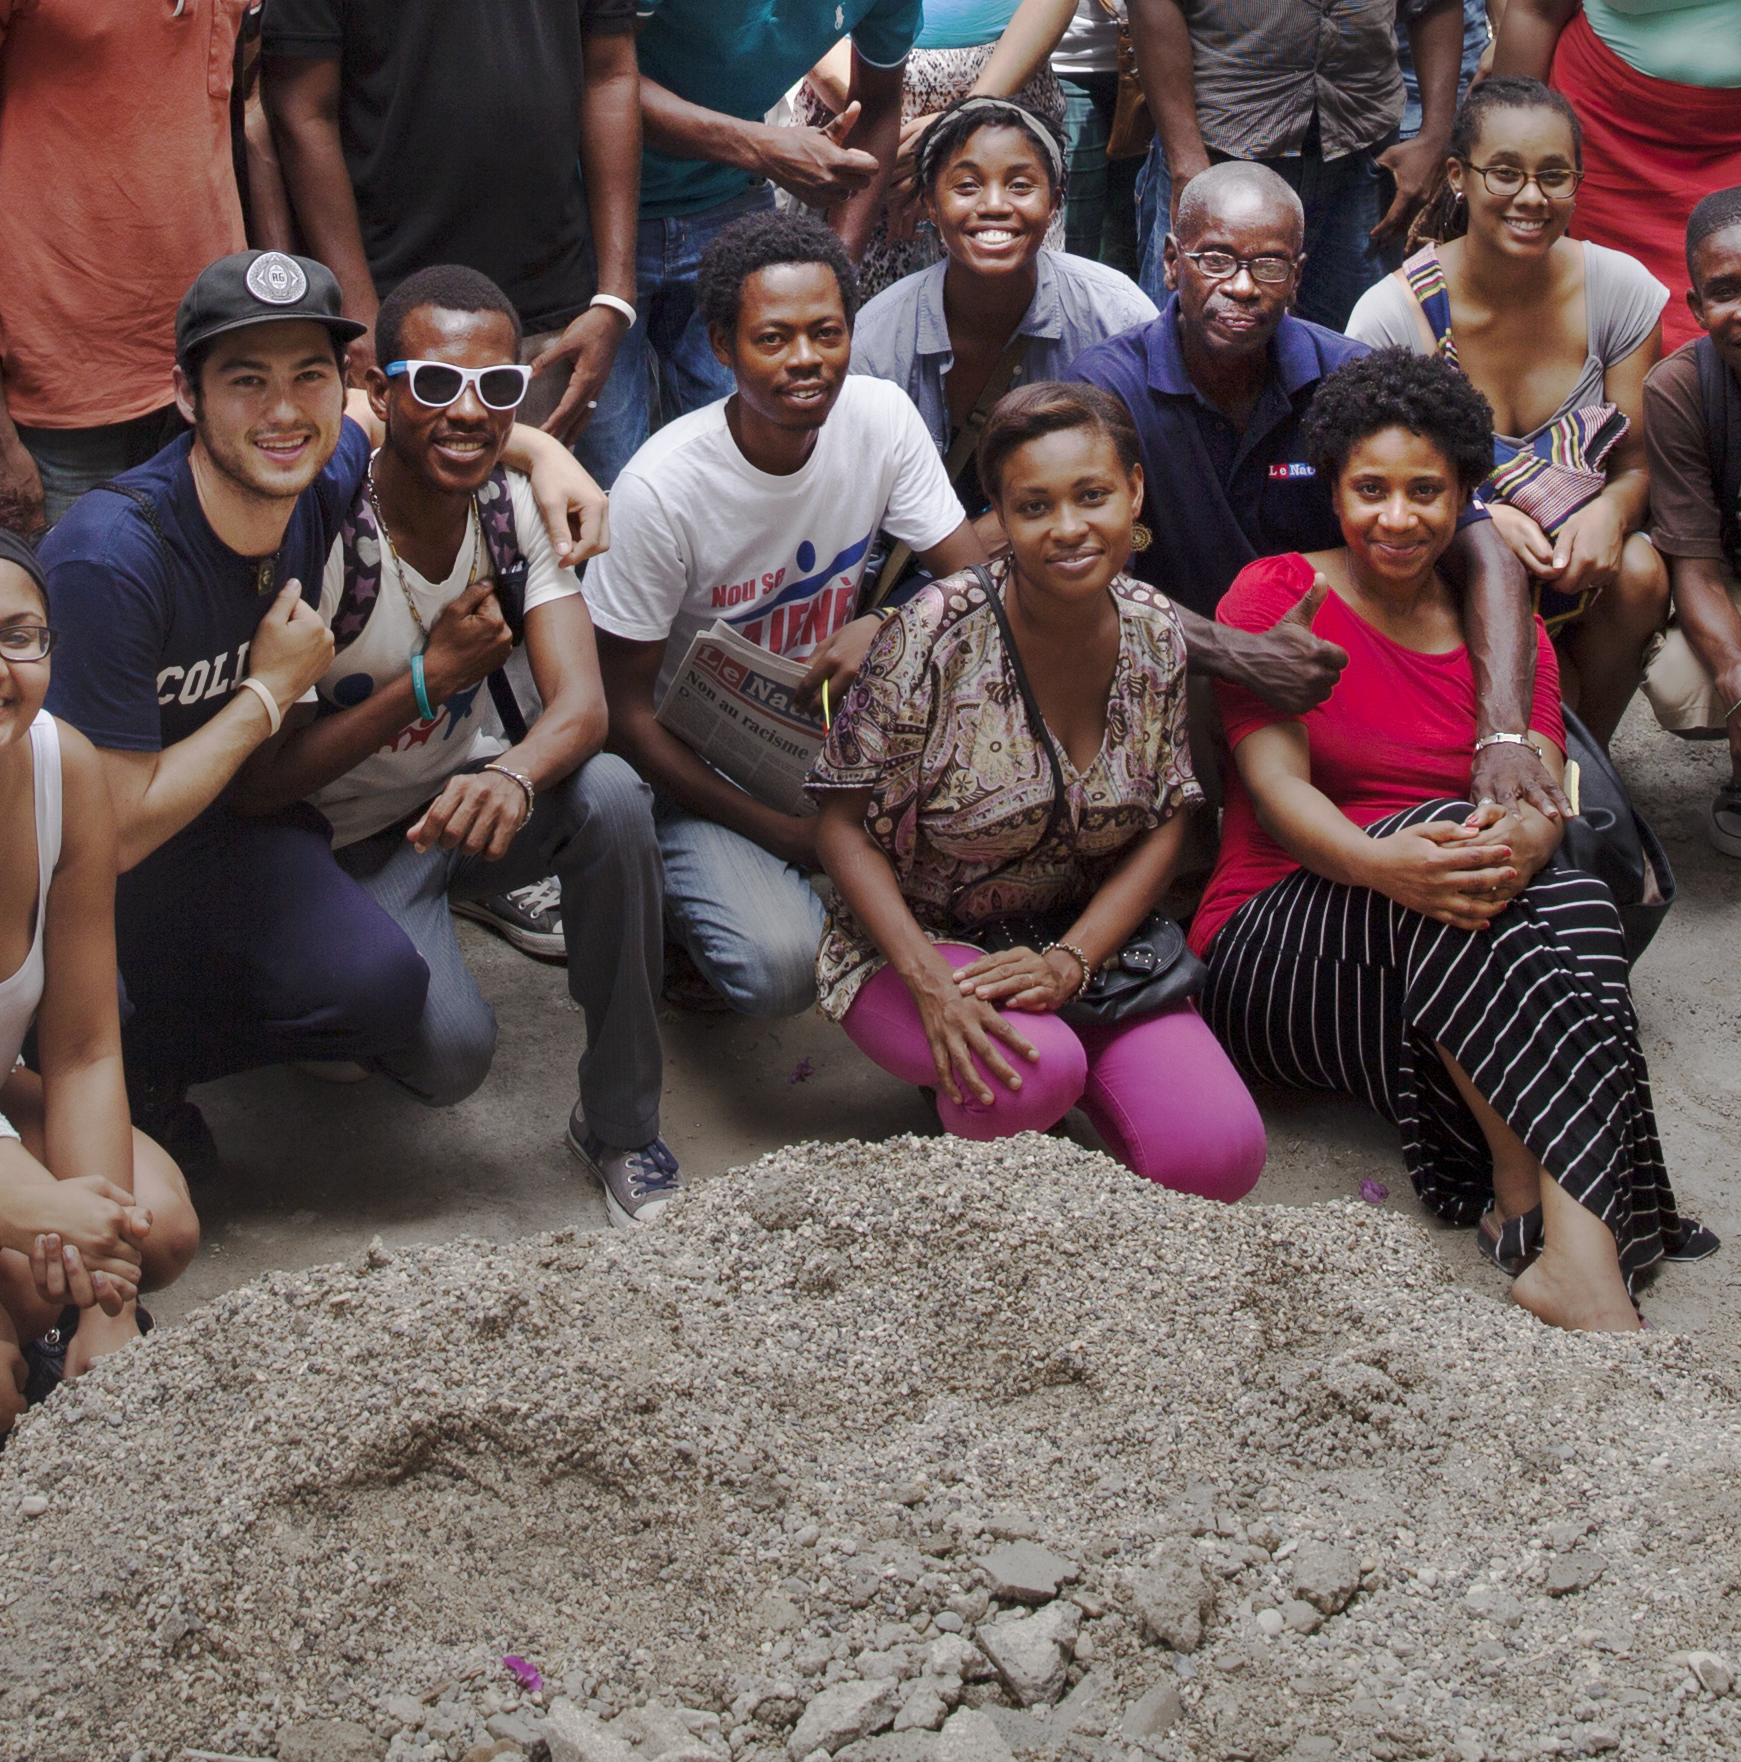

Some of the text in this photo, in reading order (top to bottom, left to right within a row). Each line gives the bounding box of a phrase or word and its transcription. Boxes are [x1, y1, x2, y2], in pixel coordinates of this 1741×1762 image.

[1268, 464, 1287, 476] Le
[696, 645, 740, 684] Le
[685, 669, 717, 702] Non
[718, 699, 740, 720] au
[741, 715, 810, 761] racisme
